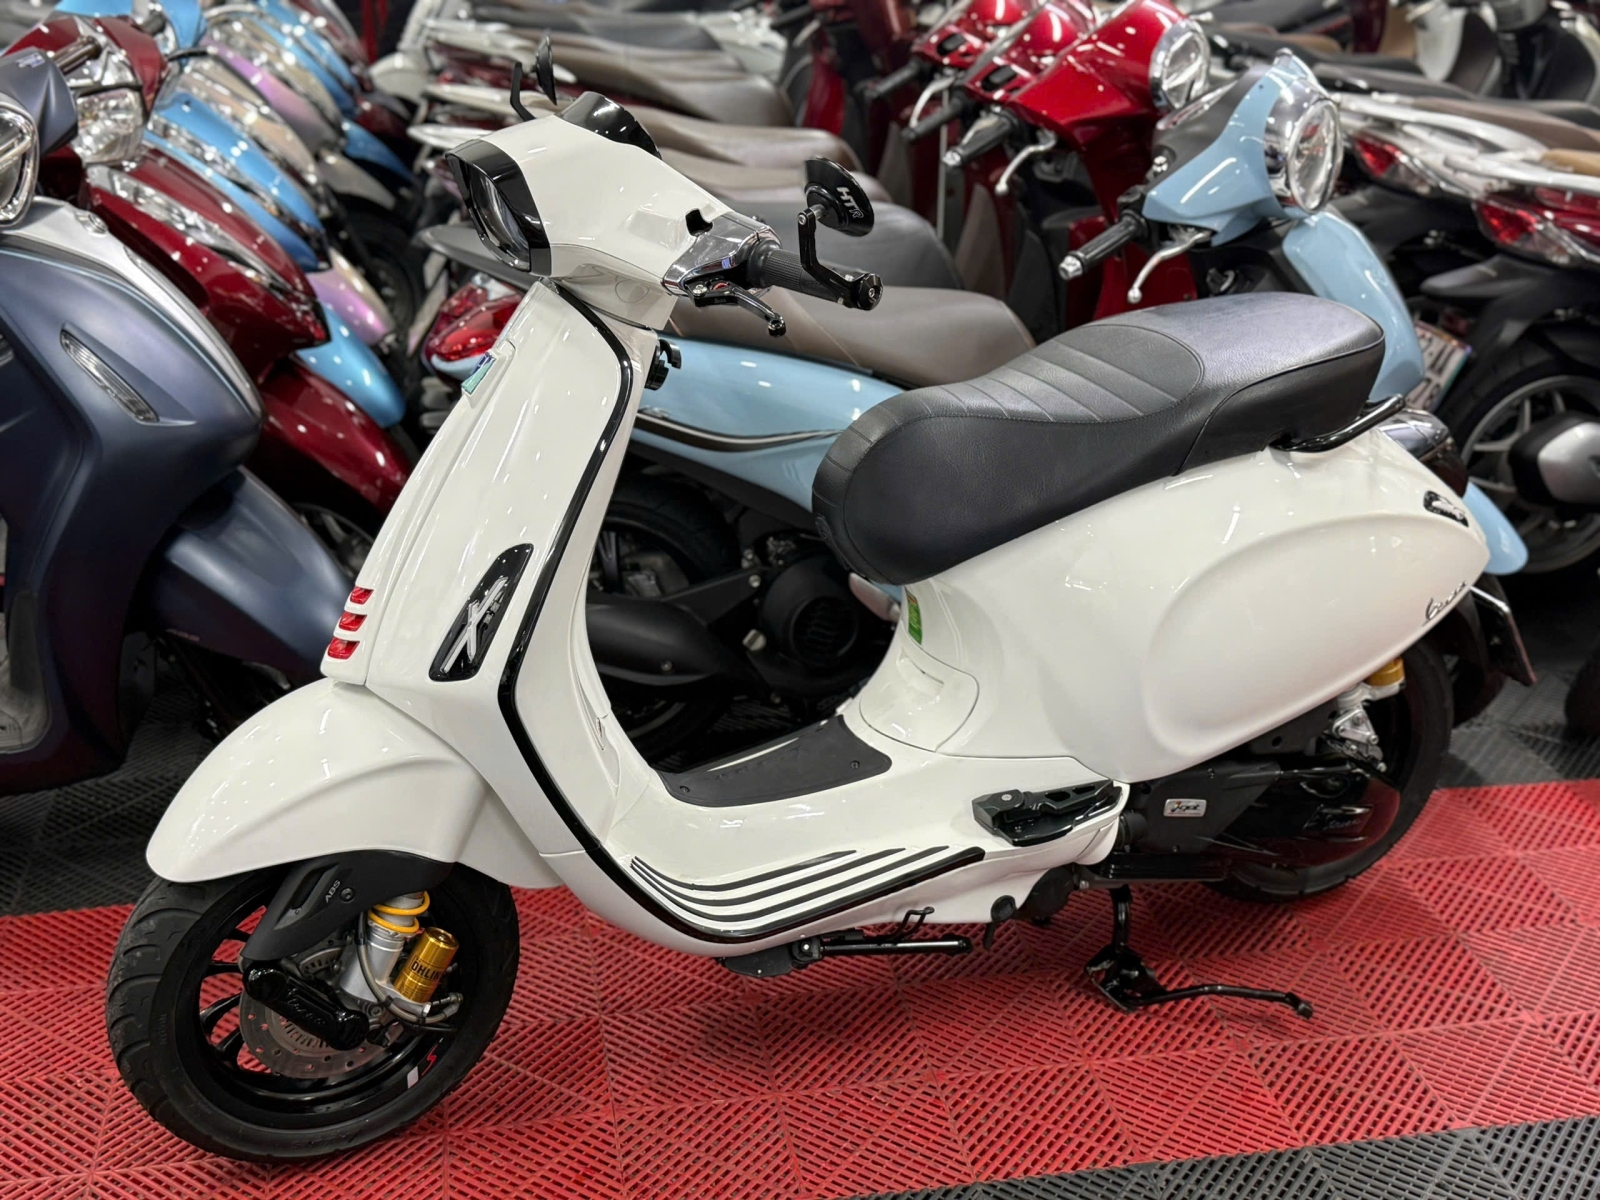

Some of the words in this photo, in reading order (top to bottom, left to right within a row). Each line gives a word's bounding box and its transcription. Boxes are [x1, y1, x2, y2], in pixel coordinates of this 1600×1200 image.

[836, 186, 865, 219] HTR
[325, 879, 341, 904] ABS
[411, 957, 442, 981] ÖHLIN
